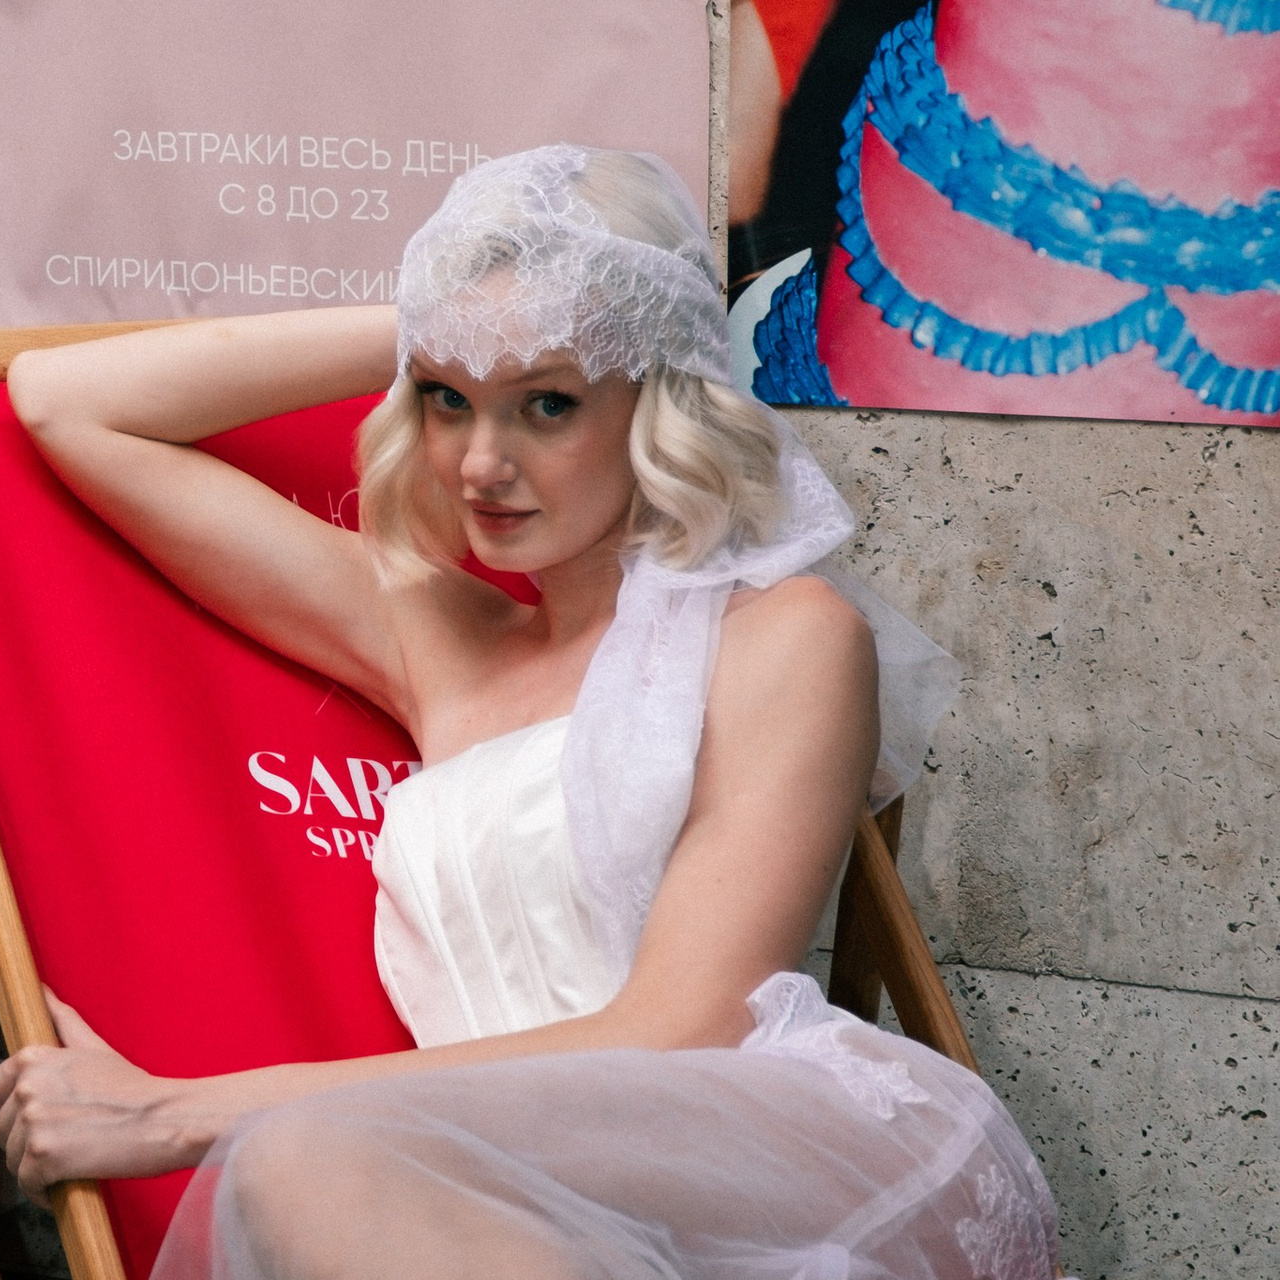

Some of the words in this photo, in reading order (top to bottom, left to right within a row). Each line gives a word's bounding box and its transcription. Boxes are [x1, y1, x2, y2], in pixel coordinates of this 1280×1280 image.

[114, 129, 287, 165] ЗАВТРАКИ
[300, 136, 391, 170] ВЕСЬ
[219, 183, 245, 214] С
[258, 184, 276, 215] 8
[286, 186, 338, 222] ДО
[351, 189, 389, 221] 23
[306, 826, 378, 861] SPR
